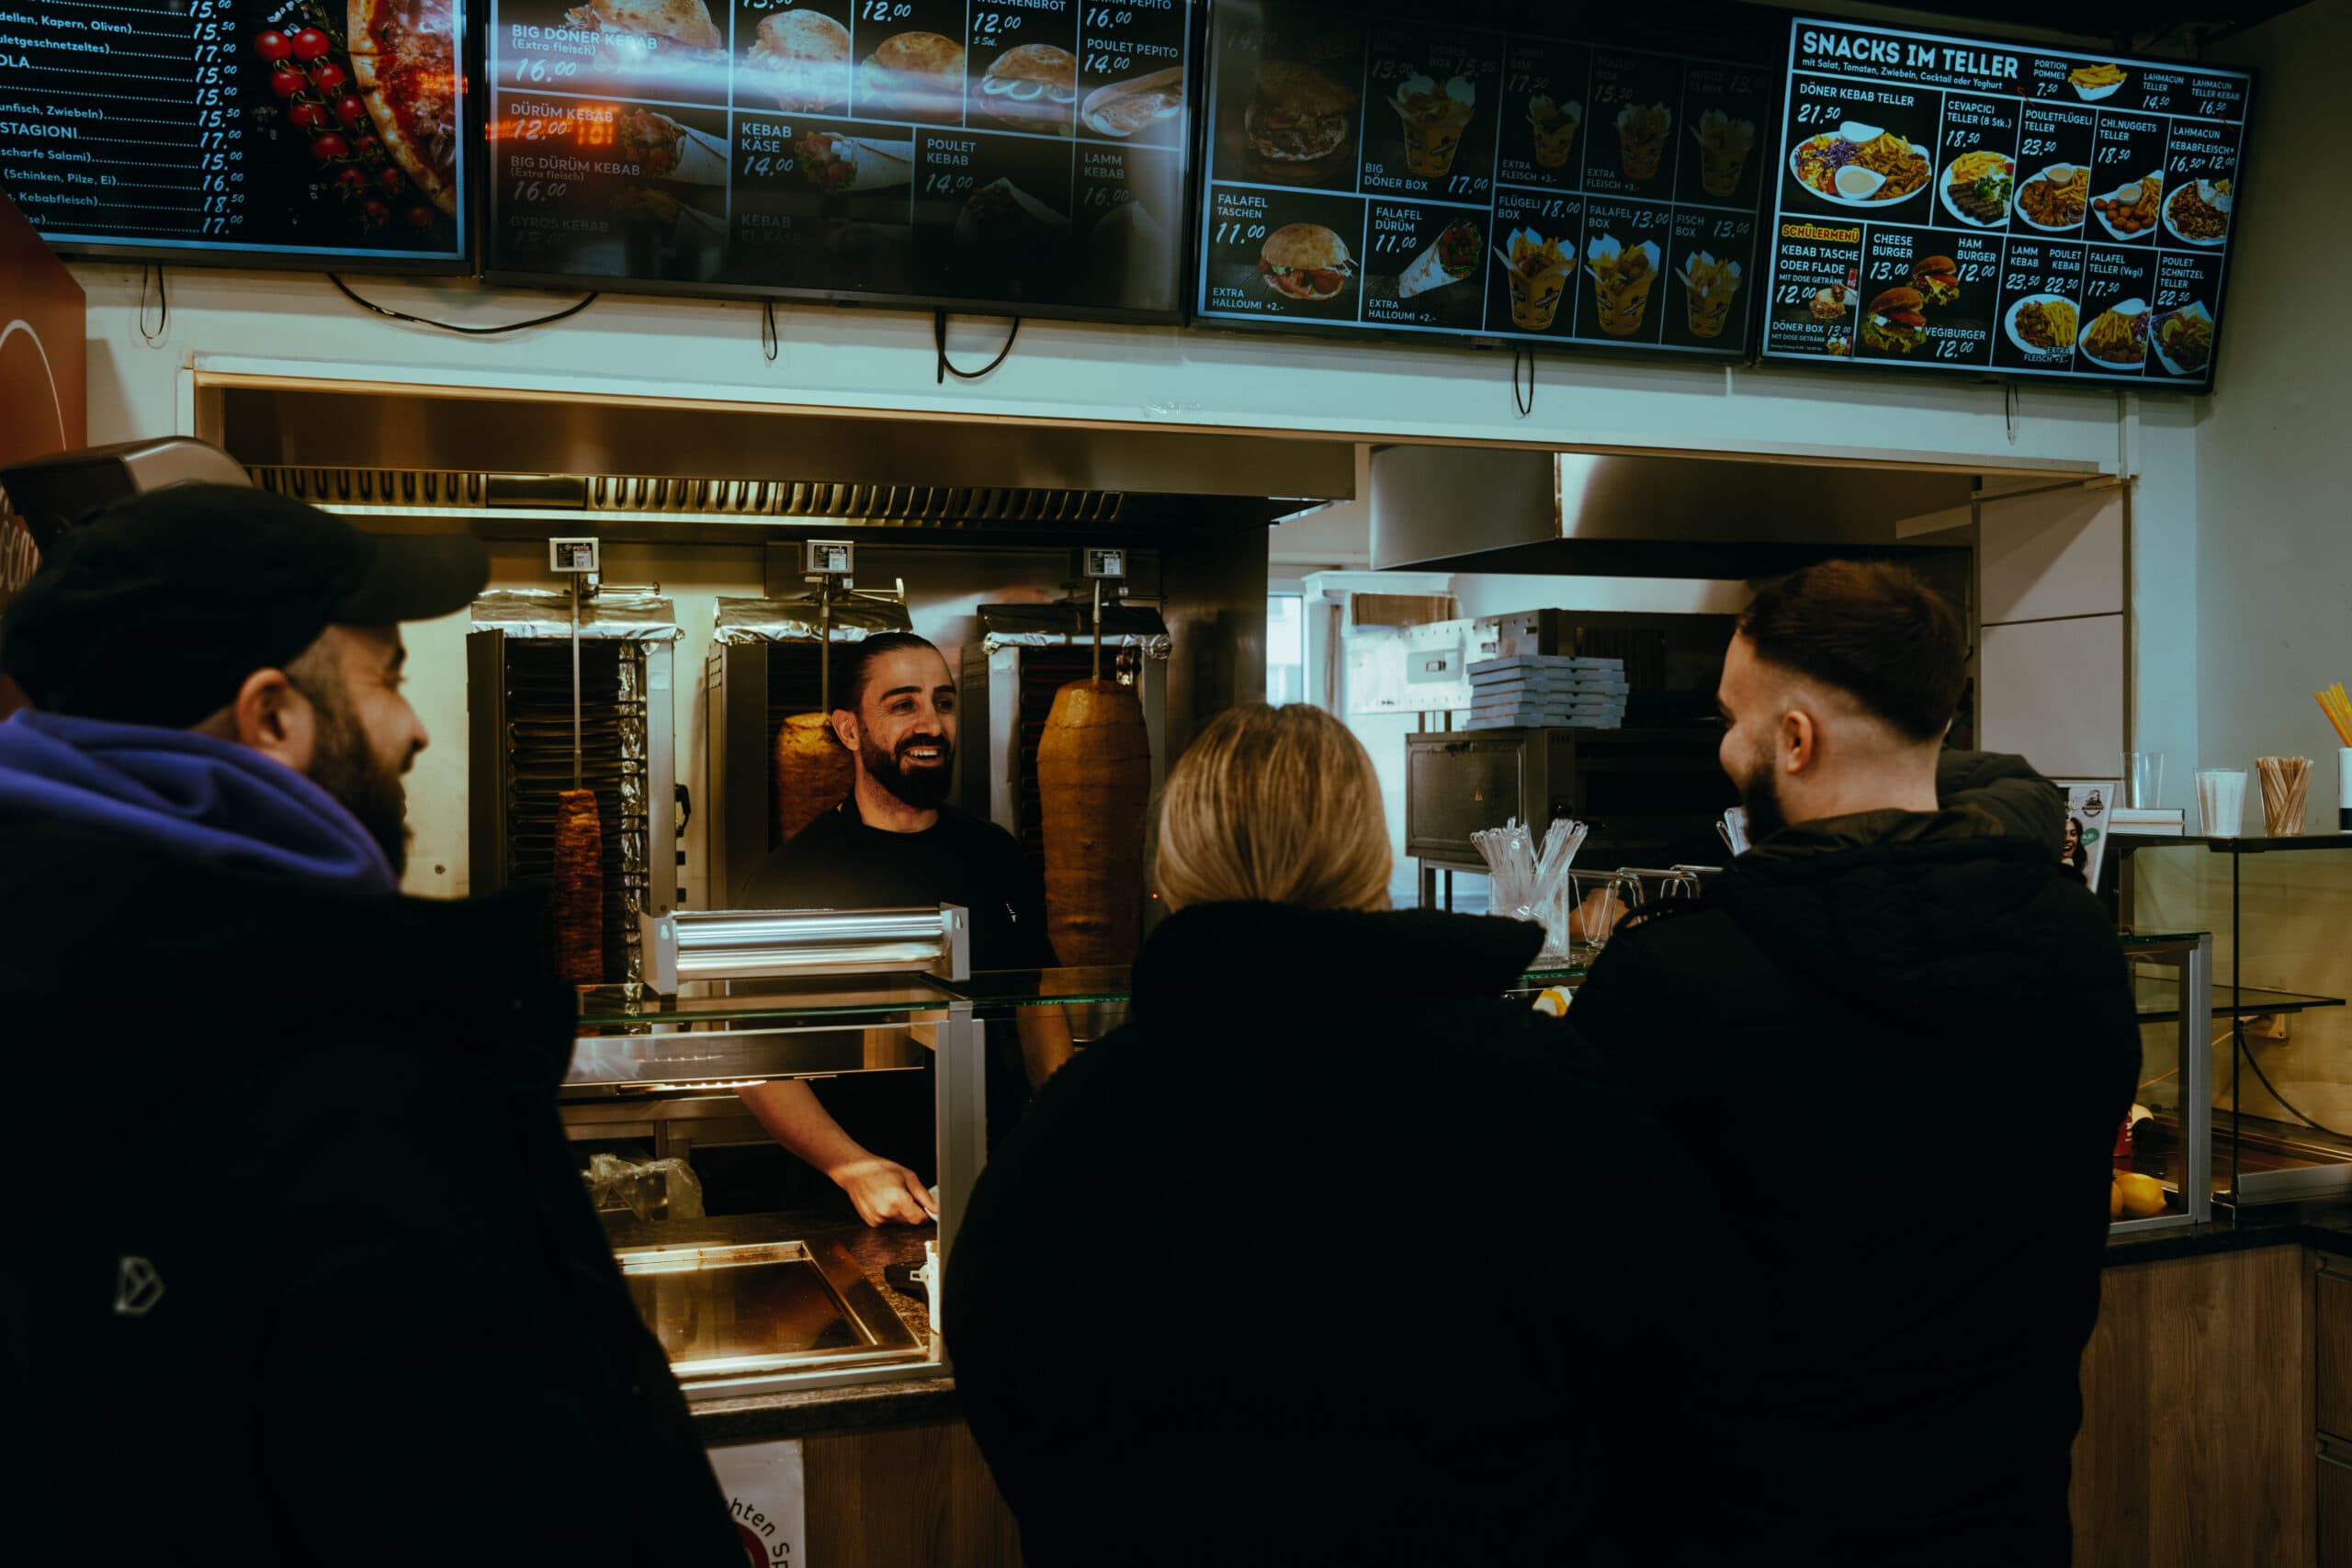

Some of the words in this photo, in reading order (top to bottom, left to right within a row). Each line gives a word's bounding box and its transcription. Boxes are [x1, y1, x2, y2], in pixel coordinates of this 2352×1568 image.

[862, 0, 912, 22] 12.00
[1086, 7, 1133, 28] 16.00
[41, 15, 88, 31] Kapern,
[91, 20, 132, 35] Oliven)
[193, 21, 235, 41] 15.50
[973, 11, 1022, 34] 12.00
[512, 24, 540, 39] BIG
[545, 25, 600, 45] DÖNER
[605, 33, 659, 51] KEBAB
[512, 38, 549, 51] (Extra
[195, 44, 236, 63] 17.00
[1087, 38, 1134, 52] POULET
[1136, 45, 1179, 59] PEPITO
[1802, 31, 1900, 64] SNACKS
[1905, 45, 1935, 69] IM
[1942, 49, 2018, 80] TELLER
[515, 58, 577, 84] 16.00
[1084, 53, 1131, 74] 14.00
[2034, 59, 2067, 71] PORTION
[196, 65, 237, 85] 15.00
[1802, 58, 1815, 67] mit
[1817, 59, 1841, 71] Salat,
[1843, 62, 1879, 75] Tomaten,
[1881, 66, 1918, 81] Zwiebeln,
[1920, 71, 1952, 85] Cocktail
[1953, 76, 1972, 86] oder
[1973, 77, 2003, 91] Yoghurt
[2033, 69, 2066, 81] POMMES
[2143, 73, 2185, 85] LAHMACUN
[2036, 82, 2058, 97] 7.50
[2143, 82, 2168, 93] TELLER
[2192, 78, 2233, 91] LAHMACUN
[196, 87, 237, 107] 15.00
[1800, 81, 1838, 98] DÖNER
[1839, 85, 1874, 103] KEBAB
[1876, 92, 1915, 107] TELLER
[2142, 95, 2170, 109] 14.50
[2191, 87, 2217, 98] TELLER
[2217, 90, 2240, 101] KEBAB
[511, 101, 563, 118] DÜRÜM
[566, 107, 614, 123] KEBAB
[1797, 103, 1841, 125] 21.50
[1948, 100, 1996, 115] CEVAPCICI
[2199, 100, 2227, 116] 16.50
[46, 105, 104, 119] Zwiebeln)
[198, 108, 241, 128] 15.50
[1947, 112, 1978, 125] TELLER
[1991, 118, 2012, 130] Stk.)
[2025, 109, 2093, 126] POULETFLÜGELI
[514, 118, 567, 141] 12.00
[741, 121, 792, 138] KEBAB
[2024, 120, 2055, 133] TELLER
[2099, 129, 2130, 141] TELLER
[2173, 126, 2221, 140] LAHMACUN
[0, 121, 78, 139] STAGIONI
[200, 130, 242, 150] 17.00
[1946, 130, 1981, 148] 18.50
[741, 137, 780, 153] KÄSE
[926, 138, 977, 153] POULET
[2021, 138, 2057, 156] 23.50
[1, 146, 45, 159] scharfe
[48, 150, 92, 163] Salami)
[201, 152, 243, 172] 15.00
[926, 152, 969, 166] KEBAB
[1084, 152, 1123, 165] LAMM
[2098, 146, 2132, 164] 18.50
[511, 155, 535, 168] BIG
[539, 154, 590, 172] DÜRÜM
[594, 162, 640, 175] KEBAB
[743, 155, 794, 177] 14.00
[1084, 166, 1125, 180] KEBAB
[1365, 163, 1384, 175] BIG
[1502, 160, 1532, 170] EXTRA
[4, 167, 64, 184] (Schinken,
[68, 173, 97, 186] Pilze,
[100, 175, 117, 186] Ei)
[202, 174, 244, 192] 16.00
[925, 173, 973, 195] 14.00
[1364, 173, 1402, 188] DÖNER
[1405, 179, 1428, 191] BOX
[1448, 175, 1489, 195] 17.00
[514, 180, 567, 202] 16.00
[19, 191, 98, 207] Kebabfleisch)
[204, 194, 244, 213] 18.50
[1218, 194, 1268, 209] FALAFEL
[1498, 194, 1541, 210] FLÜGELI
[1542, 198, 1581, 220] 18.00
[1216, 207, 1262, 220] TASCHEN
[1376, 207, 1423, 221] FALAFEL
[1498, 209, 1520, 220] BOX
[1589, 205, 1632, 220] FALAFEL
[1631, 210, 1669, 230] 13.00
[1677, 214, 1705, 227] FISCH
[202, 215, 243, 234] 17.00
[1374, 219, 1415, 233] DÜRÜM
[1589, 217, 1611, 229] BOX
[1675, 226, 1697, 238] BOX
[1713, 220, 1750, 240] 13.00
[1216, 221, 1265, 245] 11.00
[1781, 223, 1860, 243] SCHÜLERMENÜ
[1873, 233, 1914, 247] CHEESE
[1374, 233, 1417, 254] 11.00
[1958, 237, 1983, 249] HAM
[2011, 245, 2039, 256] LAMM
[1781, 243, 1817, 258] KEBAB
[1819, 247, 1860, 262] TASCHE
[1872, 245, 1914, 259] BURGER
[1957, 250, 1996, 264] BURGER
[2049, 248, 2083, 260] POULET
[2090, 252, 2125, 265] FALAFEL
[1780, 259, 1810, 274] ODER
[1812, 261, 1846, 275] FLADE
[2010, 256, 2040, 267] KEBAB
[2052, 260, 2081, 271] KEBAB
[2089, 263, 2119, 276] TELLER
[2162, 256, 2195, 267] POULET
[1779, 273, 1792, 281] MIT
[1792, 275, 1812, 283] DOSE
[1869, 261, 1910, 281] 13.00
[1957, 263, 1996, 283] 12.00
[2006, 273, 2041, 291] 23.50
[2044, 276, 2079, 294] 22.50
[2086, 279, 2120, 298] 17.50
[2160, 277, 2188, 288] TELLER
[1213, 287, 1245, 299] EXTRA
[1775, 284, 1817, 305] 12.00
[2157, 289, 2190, 306] 22.50
[1212, 298, 1262, 310] HALLOUMI
[1266, 301, 1285, 312] +2.-
[1368, 299, 1399, 310] EXTRA
[1368, 309, 1416, 321] HALLOUMI
[1771, 319, 1804, 333] DÖNER
[1805, 322, 1825, 334] BOX
[1925, 326, 1986, 341] VEGIBURGER
[1935, 340, 1974, 359] 12.00
